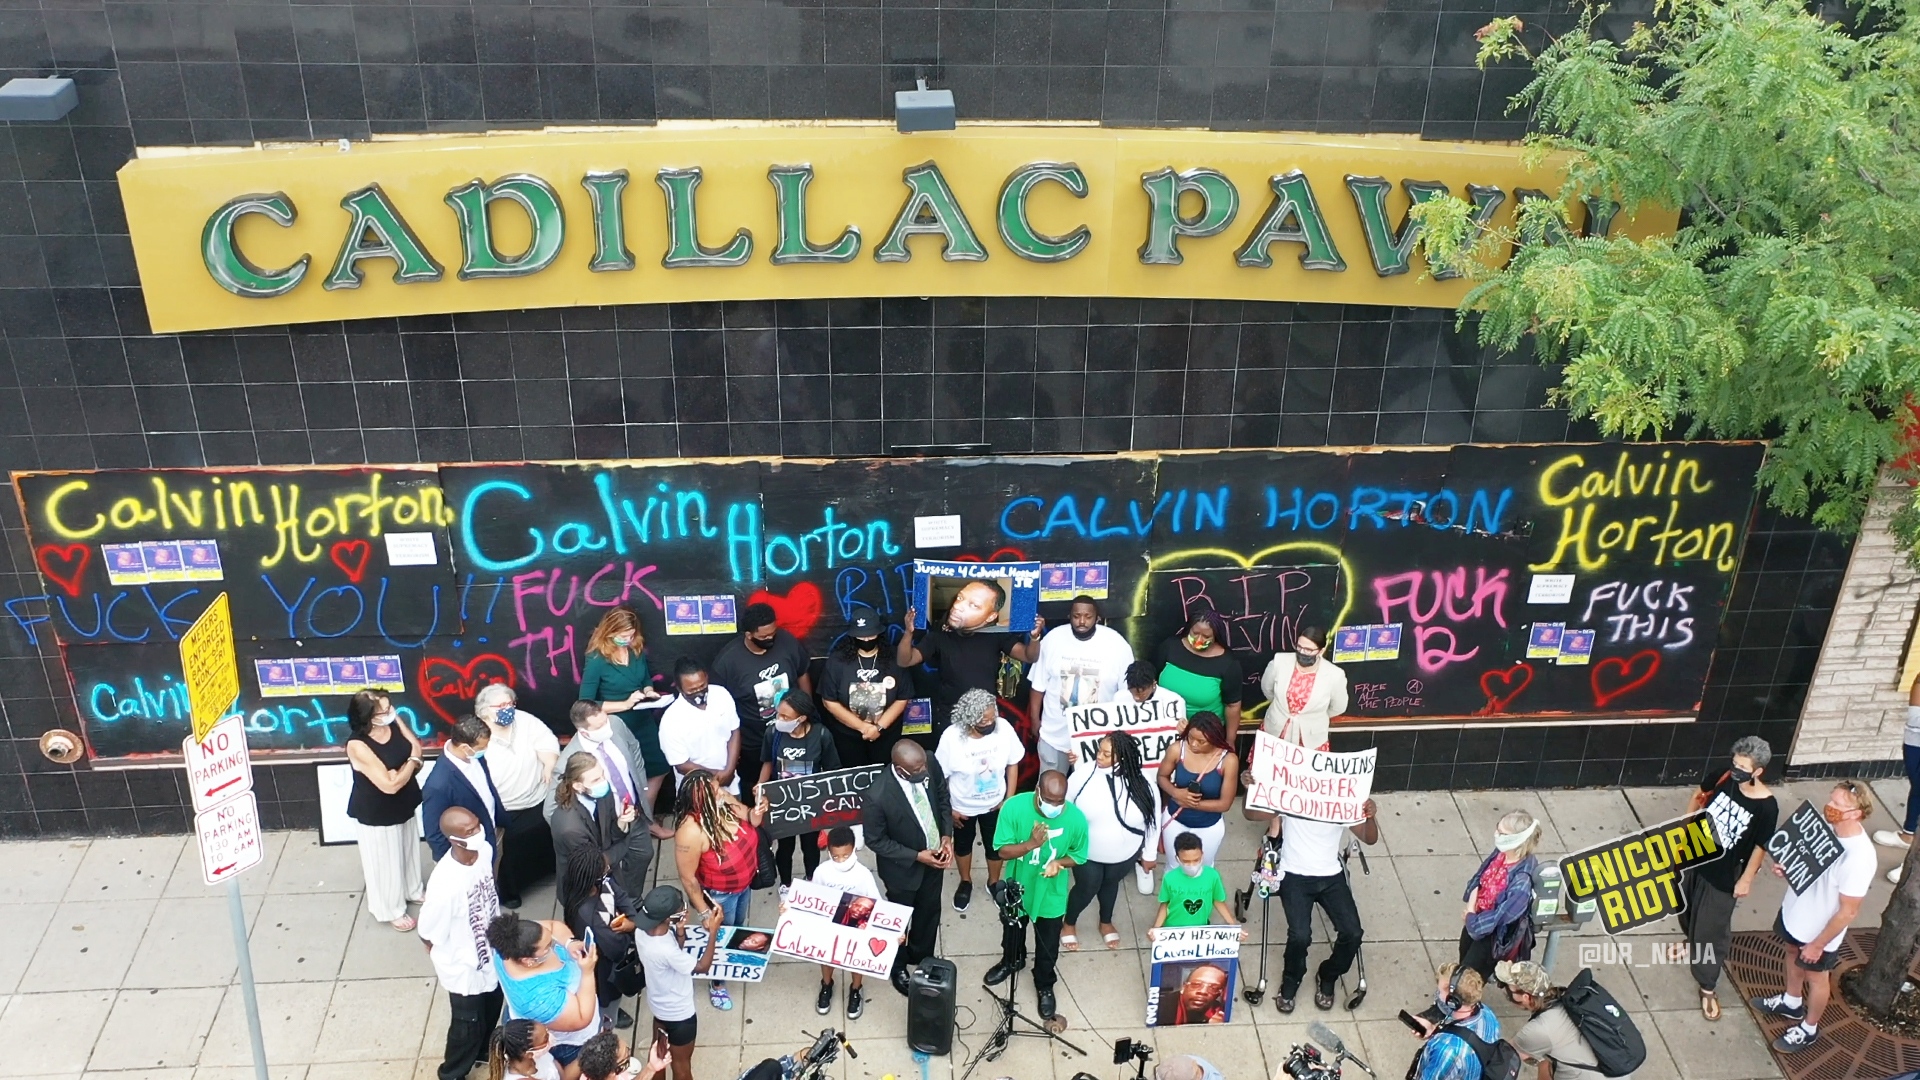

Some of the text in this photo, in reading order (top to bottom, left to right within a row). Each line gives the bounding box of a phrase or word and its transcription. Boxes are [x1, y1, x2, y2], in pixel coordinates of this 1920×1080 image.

[200, 159, 1091, 298] CADILLAC
[1539, 451, 1713, 506] Calvin
[46, 473, 454, 566] Calvin Horton
[462, 473, 899, 582] Calvin Horton
[1001, 487, 1512, 540] CALVIN HORTON
[1528, 500, 1734, 571] Horton
[914, 561, 955, 576] Justice
[958, 565, 968, 578] 4
[1014, 577, 1033, 588] JR
[513, 561, 662, 631] FUCK
[1373, 566, 1509, 629] FUCK
[1582, 579, 1693, 621] FUCK
[4, 585, 200, 645] FUCK
[191, 609, 218, 648] METERS
[1176, 604, 1309, 653] LVIN
[1605, 615, 1694, 648] THIS
[188, 620, 225, 669] ENFORCED
[508, 624, 582, 690] TH
[1354, 683, 1388, 694] FREE
[1357, 691, 1379, 704] ALL
[1358, 699, 1381, 710] THE
[1072, 700, 1179, 732] NO JUSTICE
[201, 733, 229, 759] NO
[1080, 737, 1106, 763] N
[1262, 737, 1375, 775] HOLD CALVINS
[194, 751, 243, 784] PARKING
[1272, 763, 1358, 798] MURDERER
[204, 813, 251, 842] PARKING
[217, 806, 235, 822] NO
[770, 805, 817, 824] FOR
[237, 828, 251, 840] AM
[1791, 807, 1839, 866] JUSTICE
[211, 853, 223, 864] TO
[1768, 830, 1813, 891] CALVIN
[788, 890, 902, 928] JUSTICE FOR
[831, 934, 841, 965] L
[1159, 931, 1185, 942] SAY
[1191, 929, 1211, 940] HIS
[1195, 944, 1202, 958] L
[1206, 943, 1238, 957] HORTO
[1145, 1005, 1159, 1025] DAD
